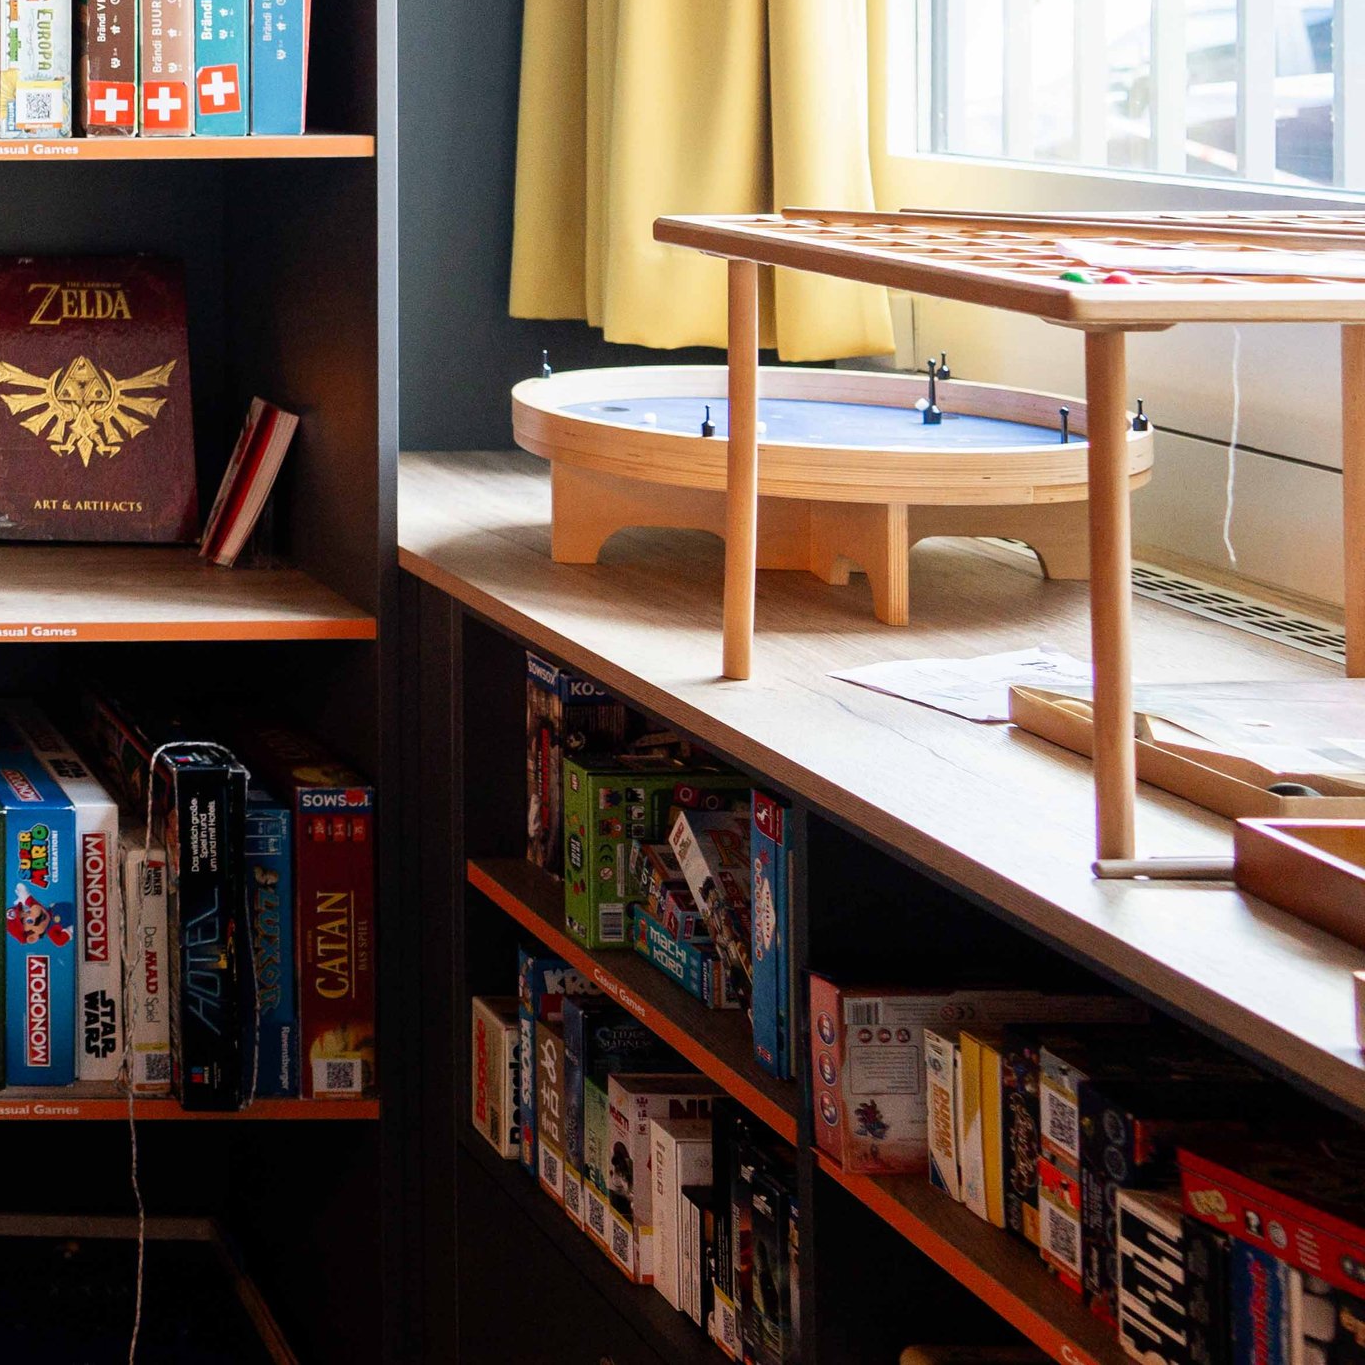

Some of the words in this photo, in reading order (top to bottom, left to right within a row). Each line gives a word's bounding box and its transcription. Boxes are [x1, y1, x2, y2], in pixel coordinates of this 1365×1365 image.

[37, 9, 53, 70] EUROPA
[34, 144, 78, 155] Games
[28, 285, 131, 326] ZELDA
[33, 500, 57, 511] ART
[62, 499, 71, 511] &
[75, 500, 143, 512] ARTIFACTS
[33, 626, 77, 637] Games
[19, 831, 30, 881] SUPER
[30, 824, 49, 889] MARIO
[84, 837, 106, 960] MONOPOLY
[145, 927, 154, 948] Das
[316, 892, 348, 998] CATAN
[650, 926, 687, 965] MACHI
[145, 951, 157, 992] MAD
[595, 969, 618, 998] Casual
[619, 989, 646, 1016] Games
[29, 959, 47, 1063] MONOPOLY
[84, 992, 98, 1057] WARS
[98, 990, 115, 1058] STAR
[145, 996, 159, 1024] Spiel
[35, 1105, 78, 1115] Games
